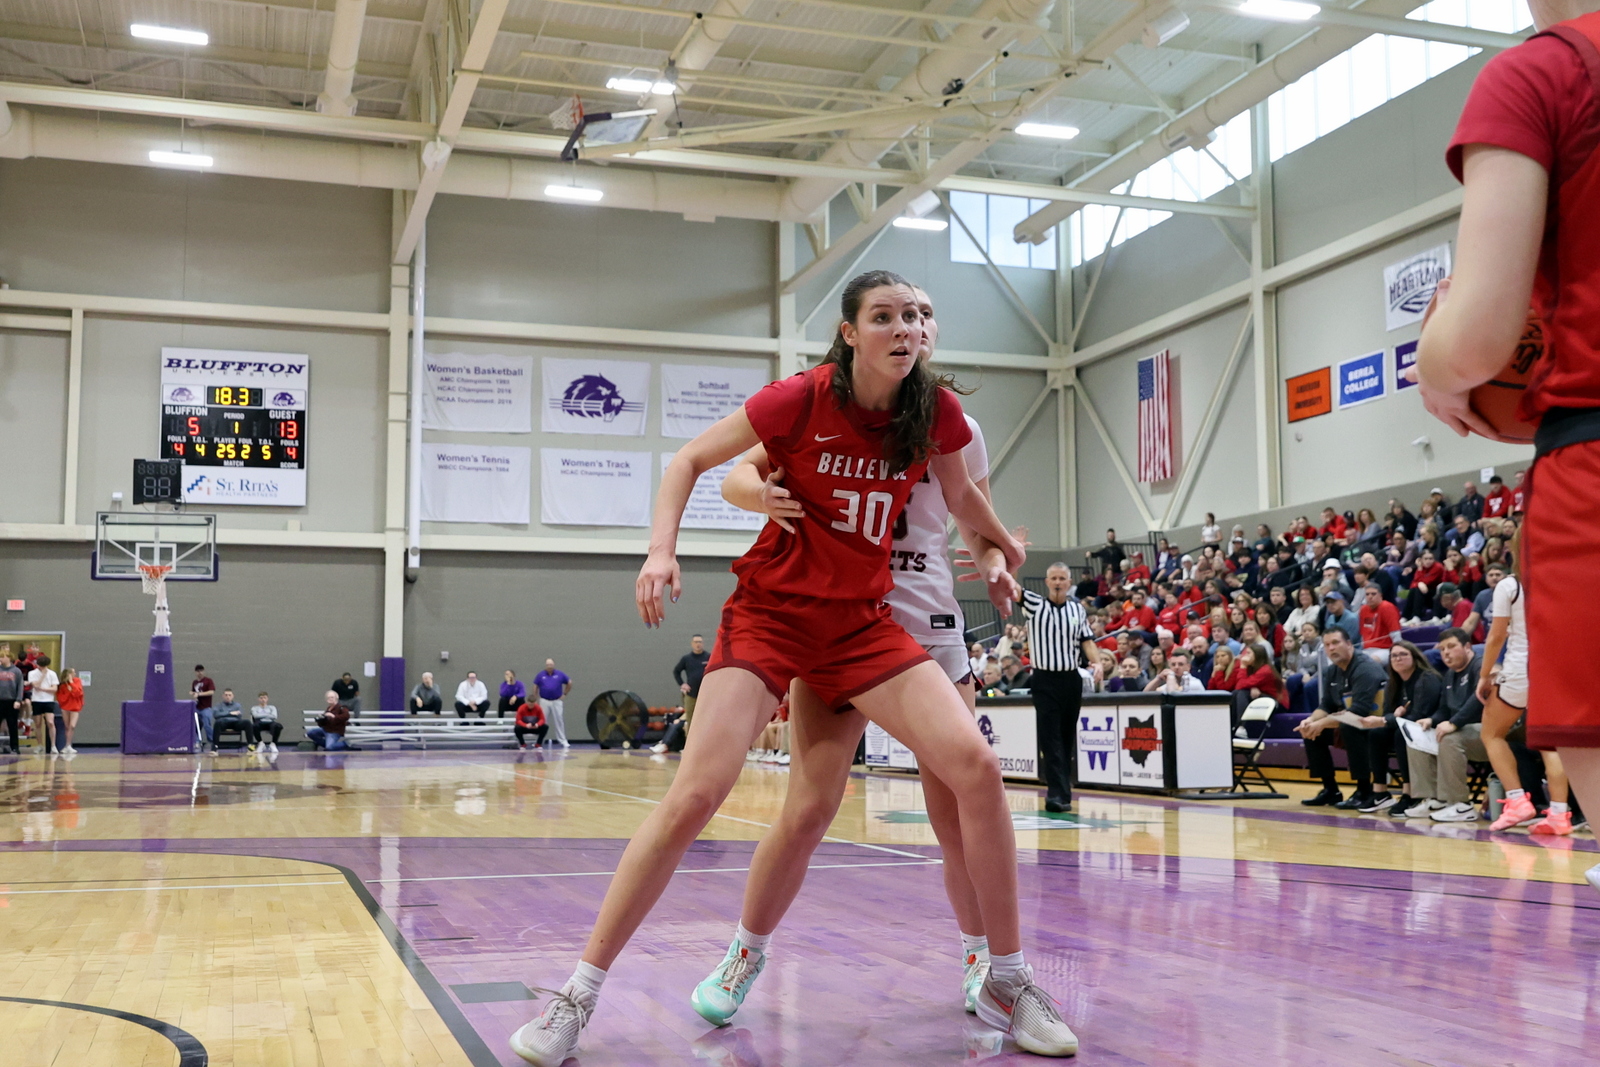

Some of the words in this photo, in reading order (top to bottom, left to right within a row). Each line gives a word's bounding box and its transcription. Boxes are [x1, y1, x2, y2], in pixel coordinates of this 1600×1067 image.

[164, 358, 306, 374] BLUFFTON
[426, 364, 471, 374] Women's
[474, 366, 524, 376] Basketball
[1347, 364, 1375, 382] BEREA
[698, 381, 730, 390] Softball
[1344, 376, 1380, 394] COLLEGE
[215, 387, 249, 406] 18.3
[165, 406, 208, 416] BLUFFTON
[224, 412, 245, 420] PERIOD
[269, 410, 297, 420] GUEST
[188, 417, 200, 436] 5
[234, 421, 240, 434] 1
[280, 421, 298, 439] 13
[168, 435, 186, 443] FOULS
[192, 436, 208, 444] T.O.L.
[258, 438, 274, 446] T.O.L.
[174, 443, 184, 455] 4
[195, 443, 206, 456] 4
[216, 444, 236, 459] 25
[241, 444, 251, 459] 2
[261, 445, 272, 460] 5
[287, 447, 296, 459] 4
[437, 454, 478, 464] Women's
[482, 455, 510, 464] Tennis
[561, 458, 603, 468] Women's
[606, 460, 630, 469] Track
[817, 452, 907, 481] BELLEV
[831, 488, 894, 546] 30
